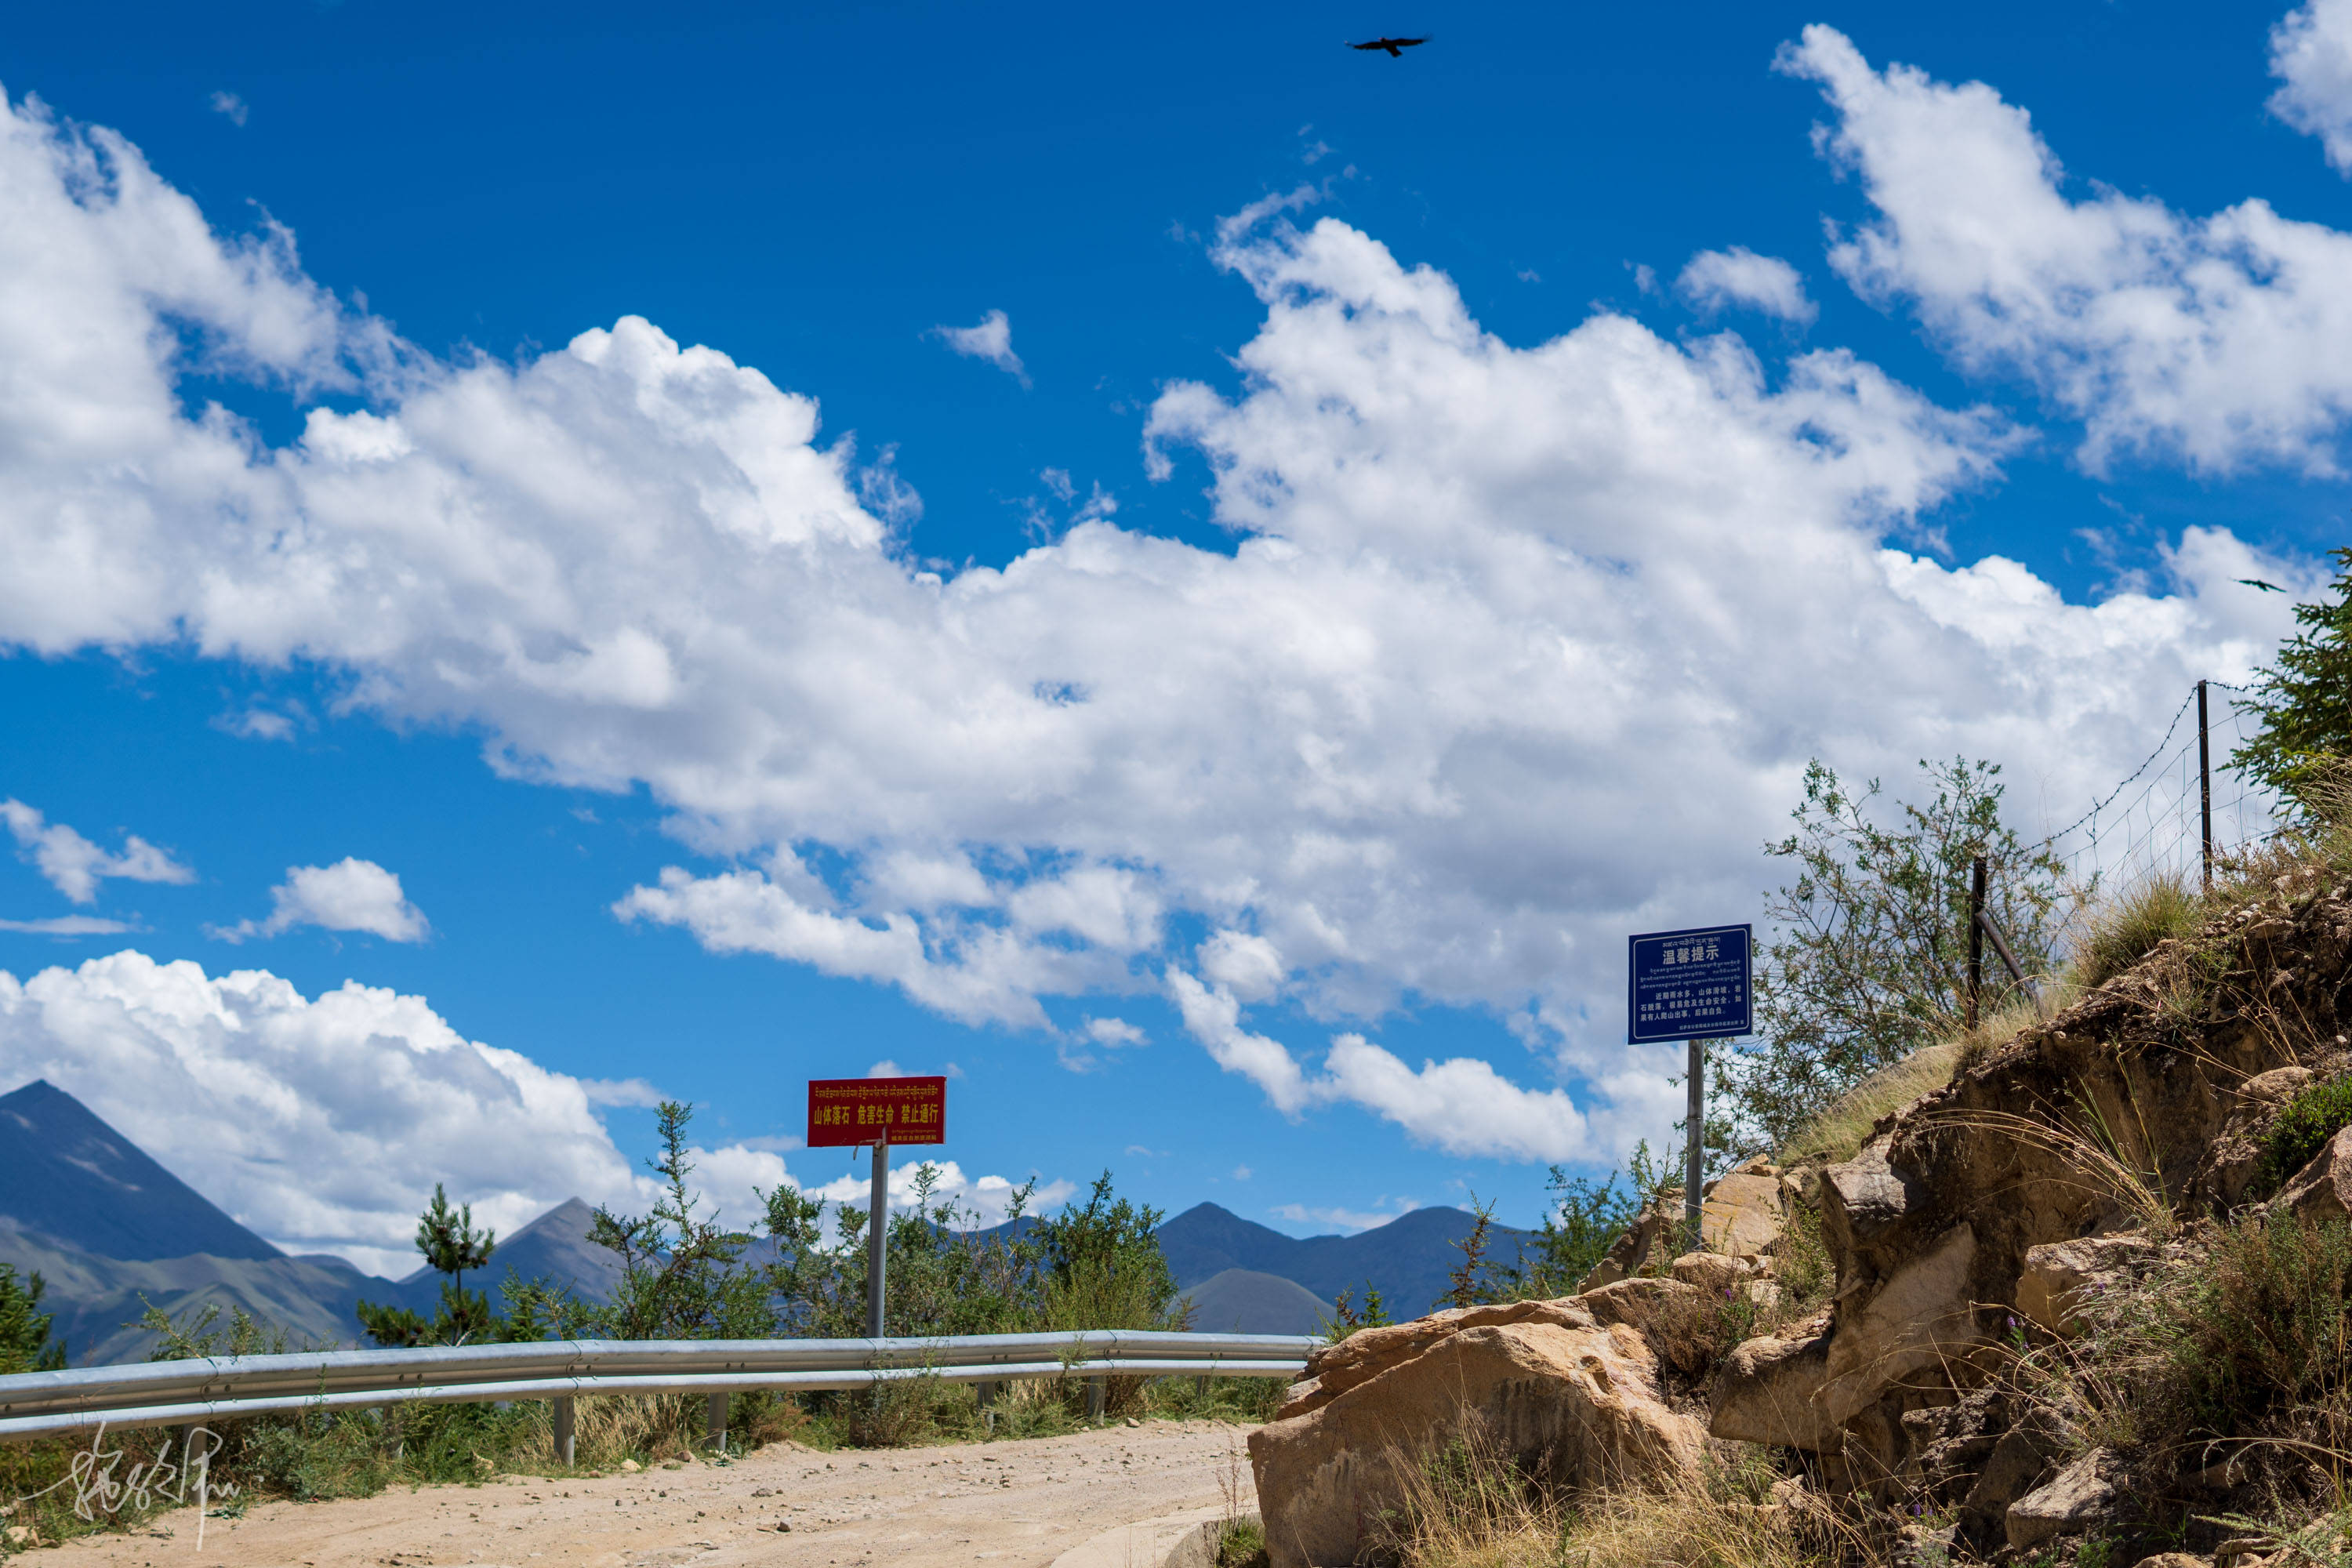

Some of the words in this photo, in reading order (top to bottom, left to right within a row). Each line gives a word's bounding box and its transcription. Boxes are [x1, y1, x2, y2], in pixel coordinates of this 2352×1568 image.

[1663, 945, 1719, 965] 温馨提示
[814, 1105, 851, 1125] 山体落石
[857, 1104, 894, 1124] 危害生命
[901, 1104, 938, 1123] 禁止通行
